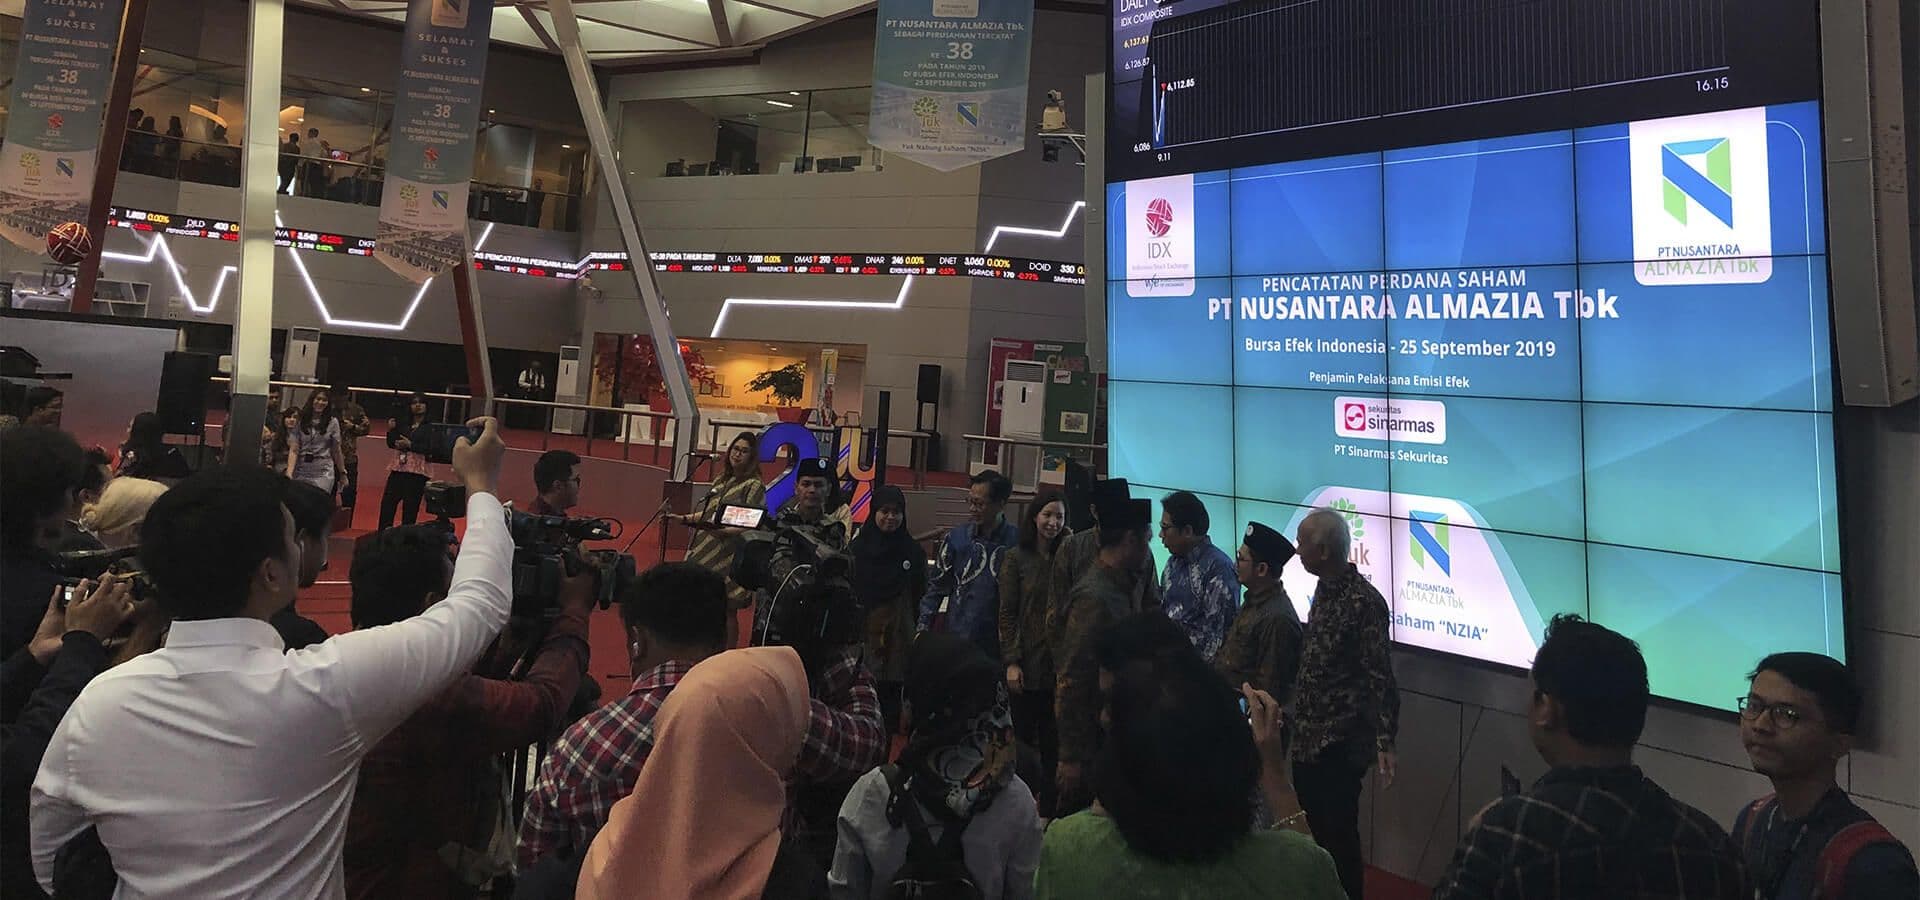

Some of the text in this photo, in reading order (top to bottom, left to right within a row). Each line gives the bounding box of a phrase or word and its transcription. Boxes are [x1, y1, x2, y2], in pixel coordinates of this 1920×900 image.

[46, 17, 96, 30] SUKSES
[1120, 6, 1173, 27] IDX COMPOSITE
[885, 20, 896, 28] PT
[899, 20, 958, 29] NUSANTARA
[960, 22, 1004, 30] ALMAZIA
[418, 33, 474, 47] SELAMAT
[947, 42, 974, 60] 38
[421, 54, 466, 66] SUKSES
[59, 69, 78, 84] 38
[1696, 77, 1729, 91] 16.15
[1167, 78, 1195, 91] 6,112.85
[433, 104, 451, 118] 38
[1157, 153, 1171, 161] 9.11
[1148, 242, 1172, 259] IDX
[1658, 244, 1741, 257] PT NUSANTARA
[865, 256, 885, 264] DNAR
[905, 256, 924, 264] 0.00%
[986, 258, 1011, 268] 0.00%
[1029, 262, 1051, 271] DOID
[1060, 264, 1075, 273] 330
[1263, 270, 1526, 292] PENCATATAN PERDANA SAHAM
[1208, 288, 1620, 320] PT NUSANTARA ALMAZIA Tbk
[1246, 338, 1281, 352] Bursa
[1285, 338, 1313, 353] Efek
[1317, 339, 1386, 354] Indonesia
[1400, 339, 1417, 354] 25
[1421, 340, 1510, 359] September
[1515, 341, 1556, 357] 2019
[1309, 372, 1470, 388] Penjamin Pelaksana Emisi Efek
[1368, 405, 1401, 414] sekuritas
[1368, 415, 1435, 433] sinarmas
[1334, 444, 1448, 465] PT Sinarmas Sekuritas
[1415, 582, 1454, 595] NUSANTARA
[1400, 587, 1445, 607] ALMAZIA
